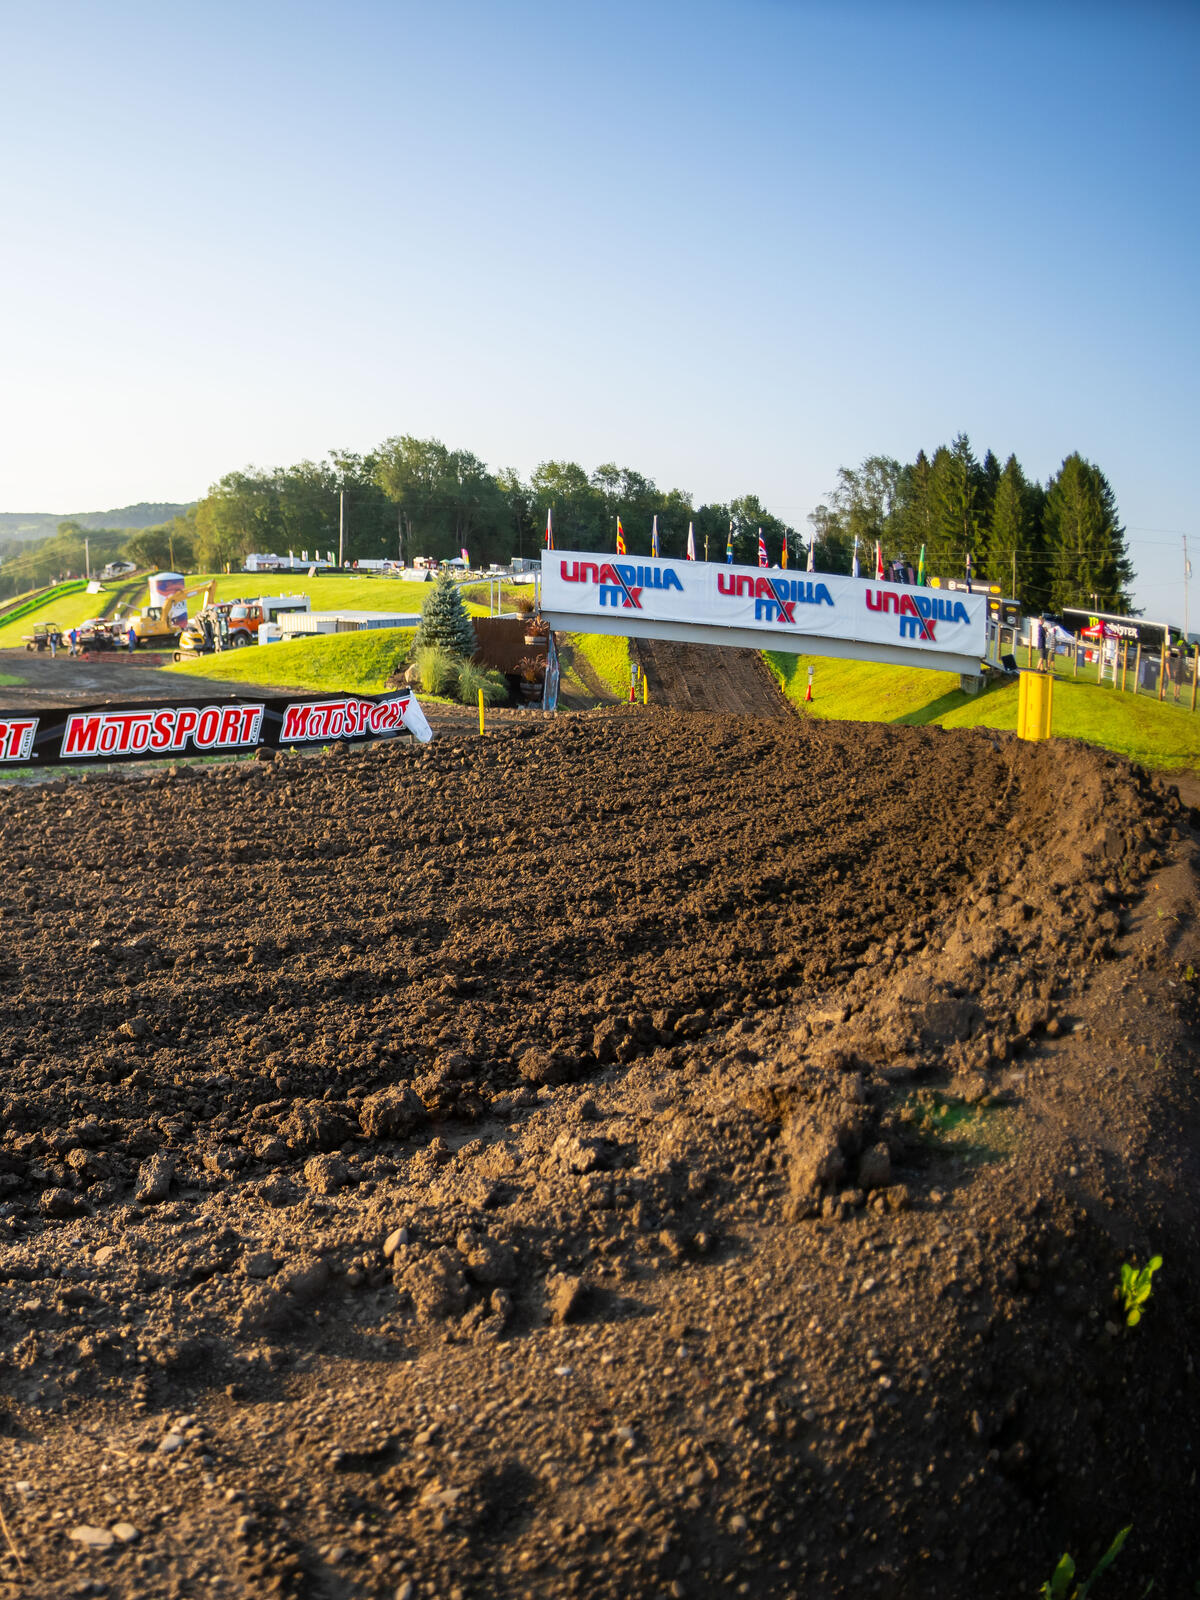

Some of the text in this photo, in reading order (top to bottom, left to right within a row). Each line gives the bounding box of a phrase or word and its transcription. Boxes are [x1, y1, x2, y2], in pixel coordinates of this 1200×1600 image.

[560, 560, 684, 591] UNADILLA
[717, 573, 834, 606] UNADILLA
[599, 584, 643, 609] MX
[865, 589, 971, 625] UNADILLA
[755, 598, 796, 624] MX
[899, 615, 937, 641] MX
